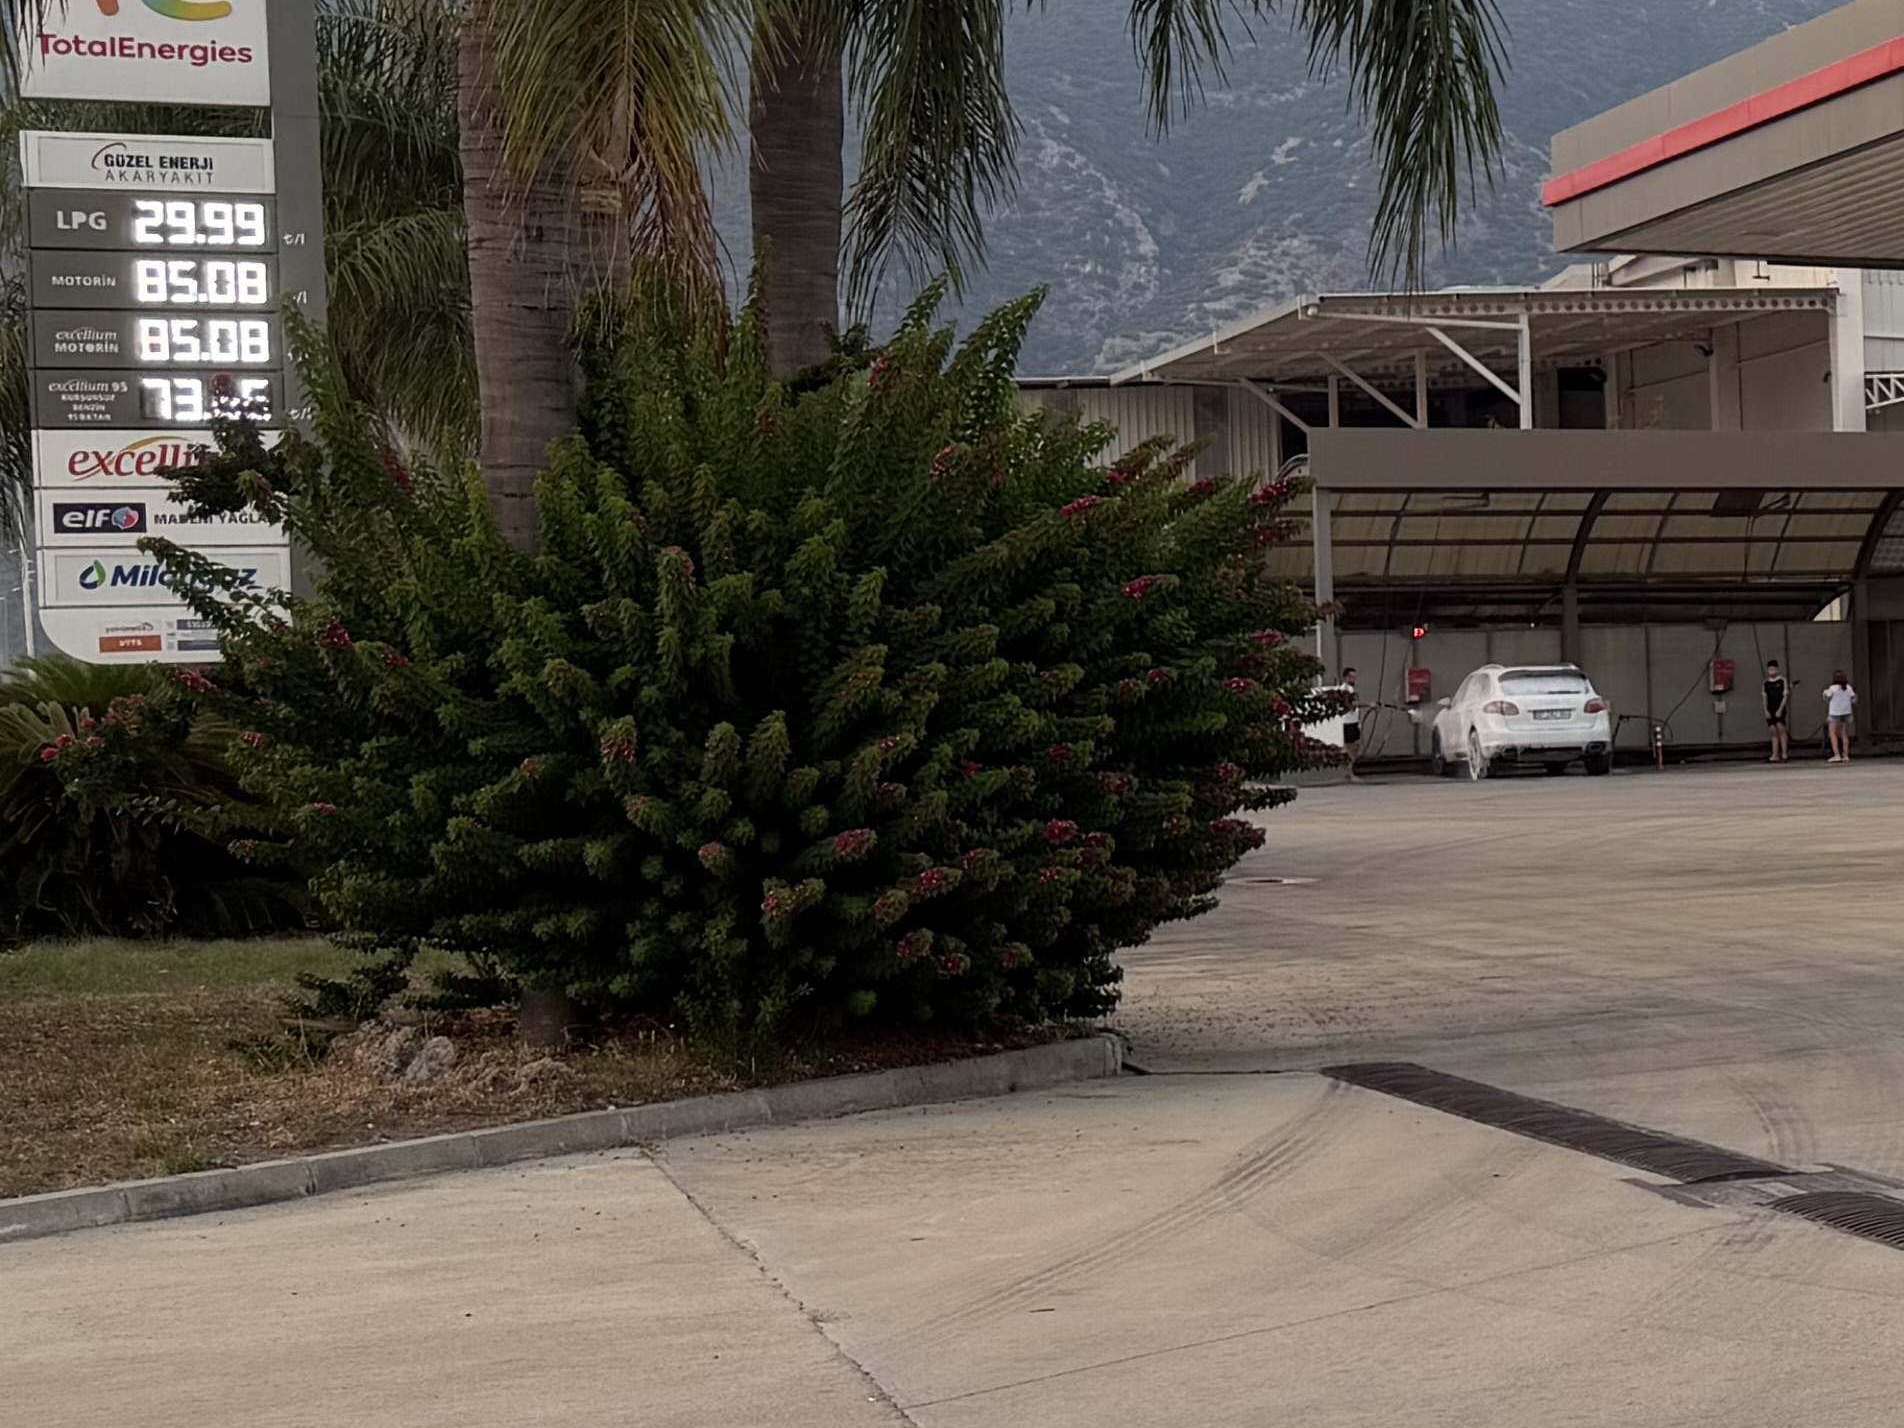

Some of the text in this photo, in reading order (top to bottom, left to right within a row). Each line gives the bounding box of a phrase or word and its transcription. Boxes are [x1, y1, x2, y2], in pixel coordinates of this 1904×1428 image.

[37, 34, 253, 67] TotalEnergies
[104, 153, 214, 170] GÜZEL ENERJİ
[104, 169, 214, 184] AKARYAKIT
[57, 200, 266, 245] LPG 29.99
[51, 260, 268, 303] MOTORİN 85.08
[54, 342, 119, 353] MOTORİN
[55, 326, 117, 341] excellium
[138, 319, 270, 362] 85.08
[48, 379, 109, 393] excellium
[111, 381, 128, 393] 95
[68, 443, 221, 476] excelli
[62, 509, 111, 528] elf
